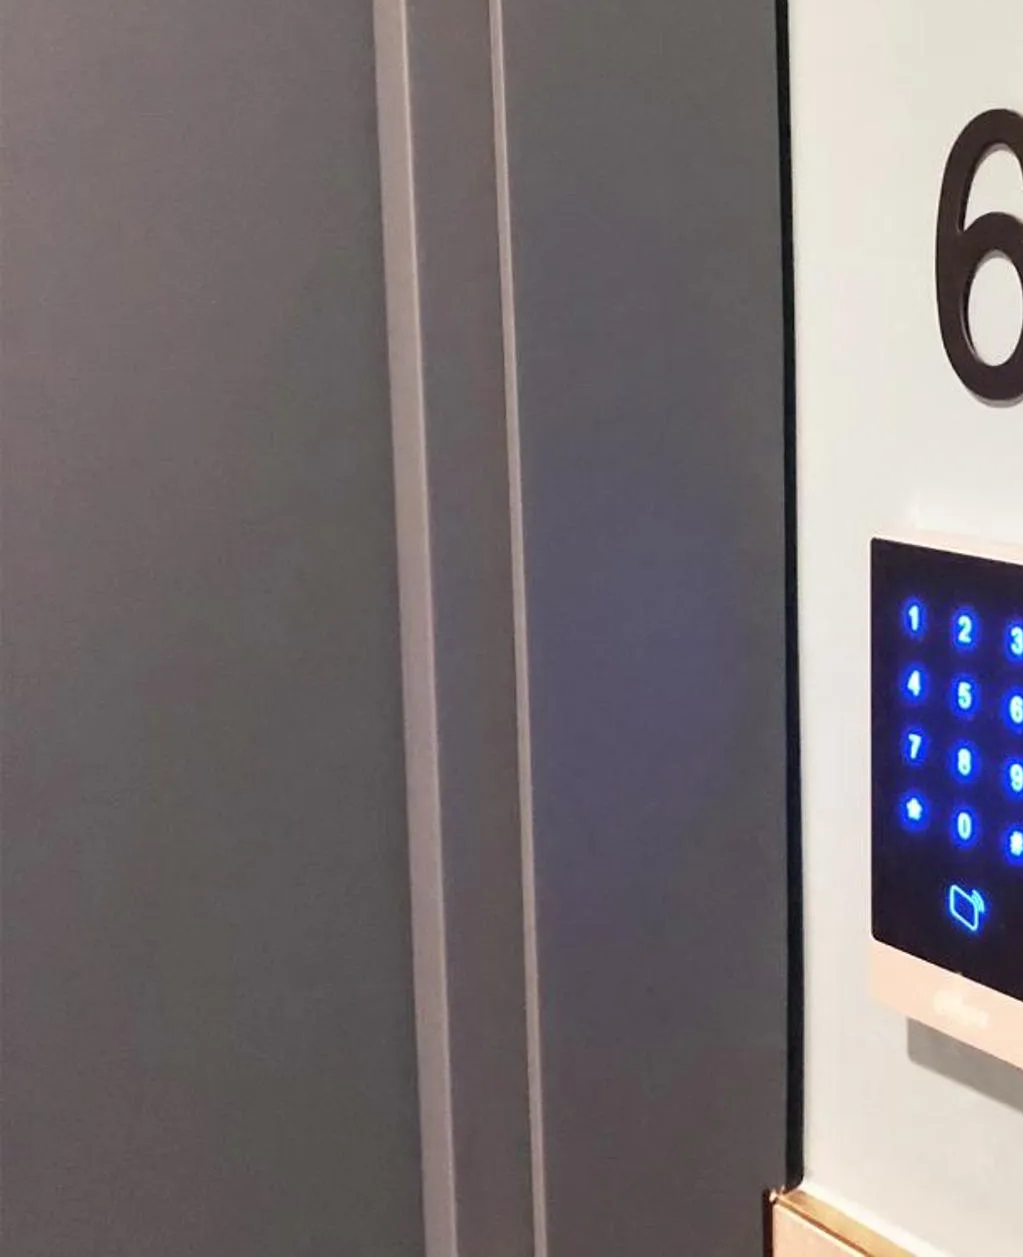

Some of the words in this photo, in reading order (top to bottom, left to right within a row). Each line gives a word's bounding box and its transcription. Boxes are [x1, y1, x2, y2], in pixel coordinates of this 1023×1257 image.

[907, 604, 921, 633] 1
[957, 614, 973, 644] 2
[906, 669, 923, 698] 4
[957, 681, 973, 711] 5
[907, 733, 923, 760] 7
[957, 747, 972, 777] 8
[957, 811, 972, 841] 0
